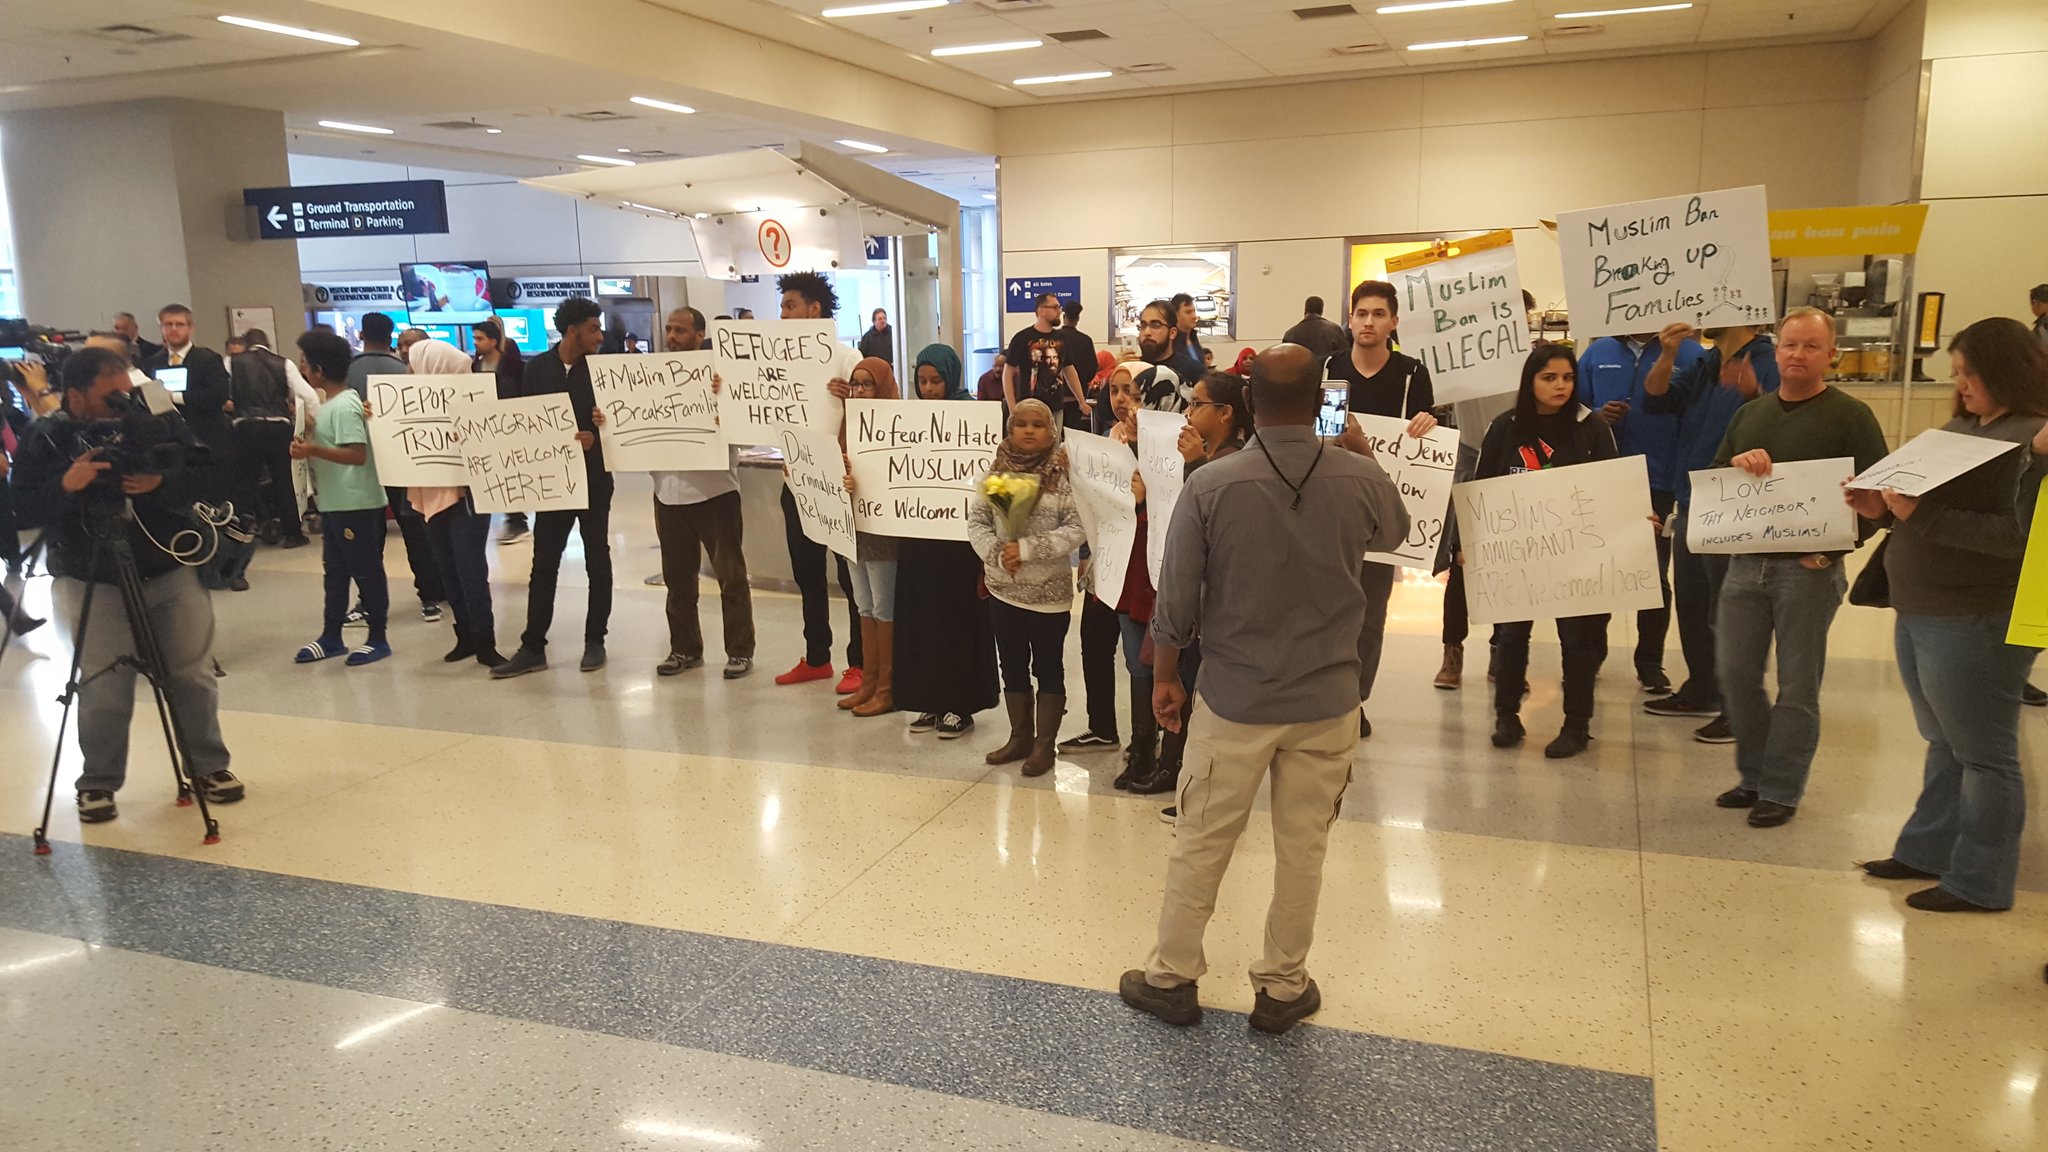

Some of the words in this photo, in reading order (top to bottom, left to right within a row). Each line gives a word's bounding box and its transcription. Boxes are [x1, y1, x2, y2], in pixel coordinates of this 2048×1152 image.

[306, 201, 342, 214] Ground
[344, 198, 415, 213] Transportation
[1685, 196, 1719, 227] Ban
[308, 217, 350, 230] Terminal
[354, 217, 362, 228] D
[366, 216, 404, 230] Parking
[522, 282, 545, 290] VISITOR
[1434, 308, 1479, 333] Ban
[1605, 286, 1705, 325] Families
[717, 328, 832, 364] REFUGEES
[1420, 320, 1527, 374] ILLEGAL
[757, 366, 788, 382] ARE
[729, 382, 808, 402] WELCOME
[606, 389, 719, 427] BreaksFamilie
[749, 404, 809, 427] HERE!
[454, 405, 575, 445] IMMIGRANTS
[859, 409, 886, 443] No
[930, 410, 951, 443] No
[958, 418, 998, 447] Hate
[468, 455, 492, 476] ARE
[499, 445, 577, 469] WELCOME
[1405, 436, 1454, 466] Jews
[484, 471, 561, 507] HERE
[858, 498, 883, 519] are
[895, 496, 960, 520] Welcome
[1699, 510, 1724, 526] THY
[1467, 524, 1606, 575] IMMIGRANTS
[1702, 532, 1753, 547] INCLUDES
